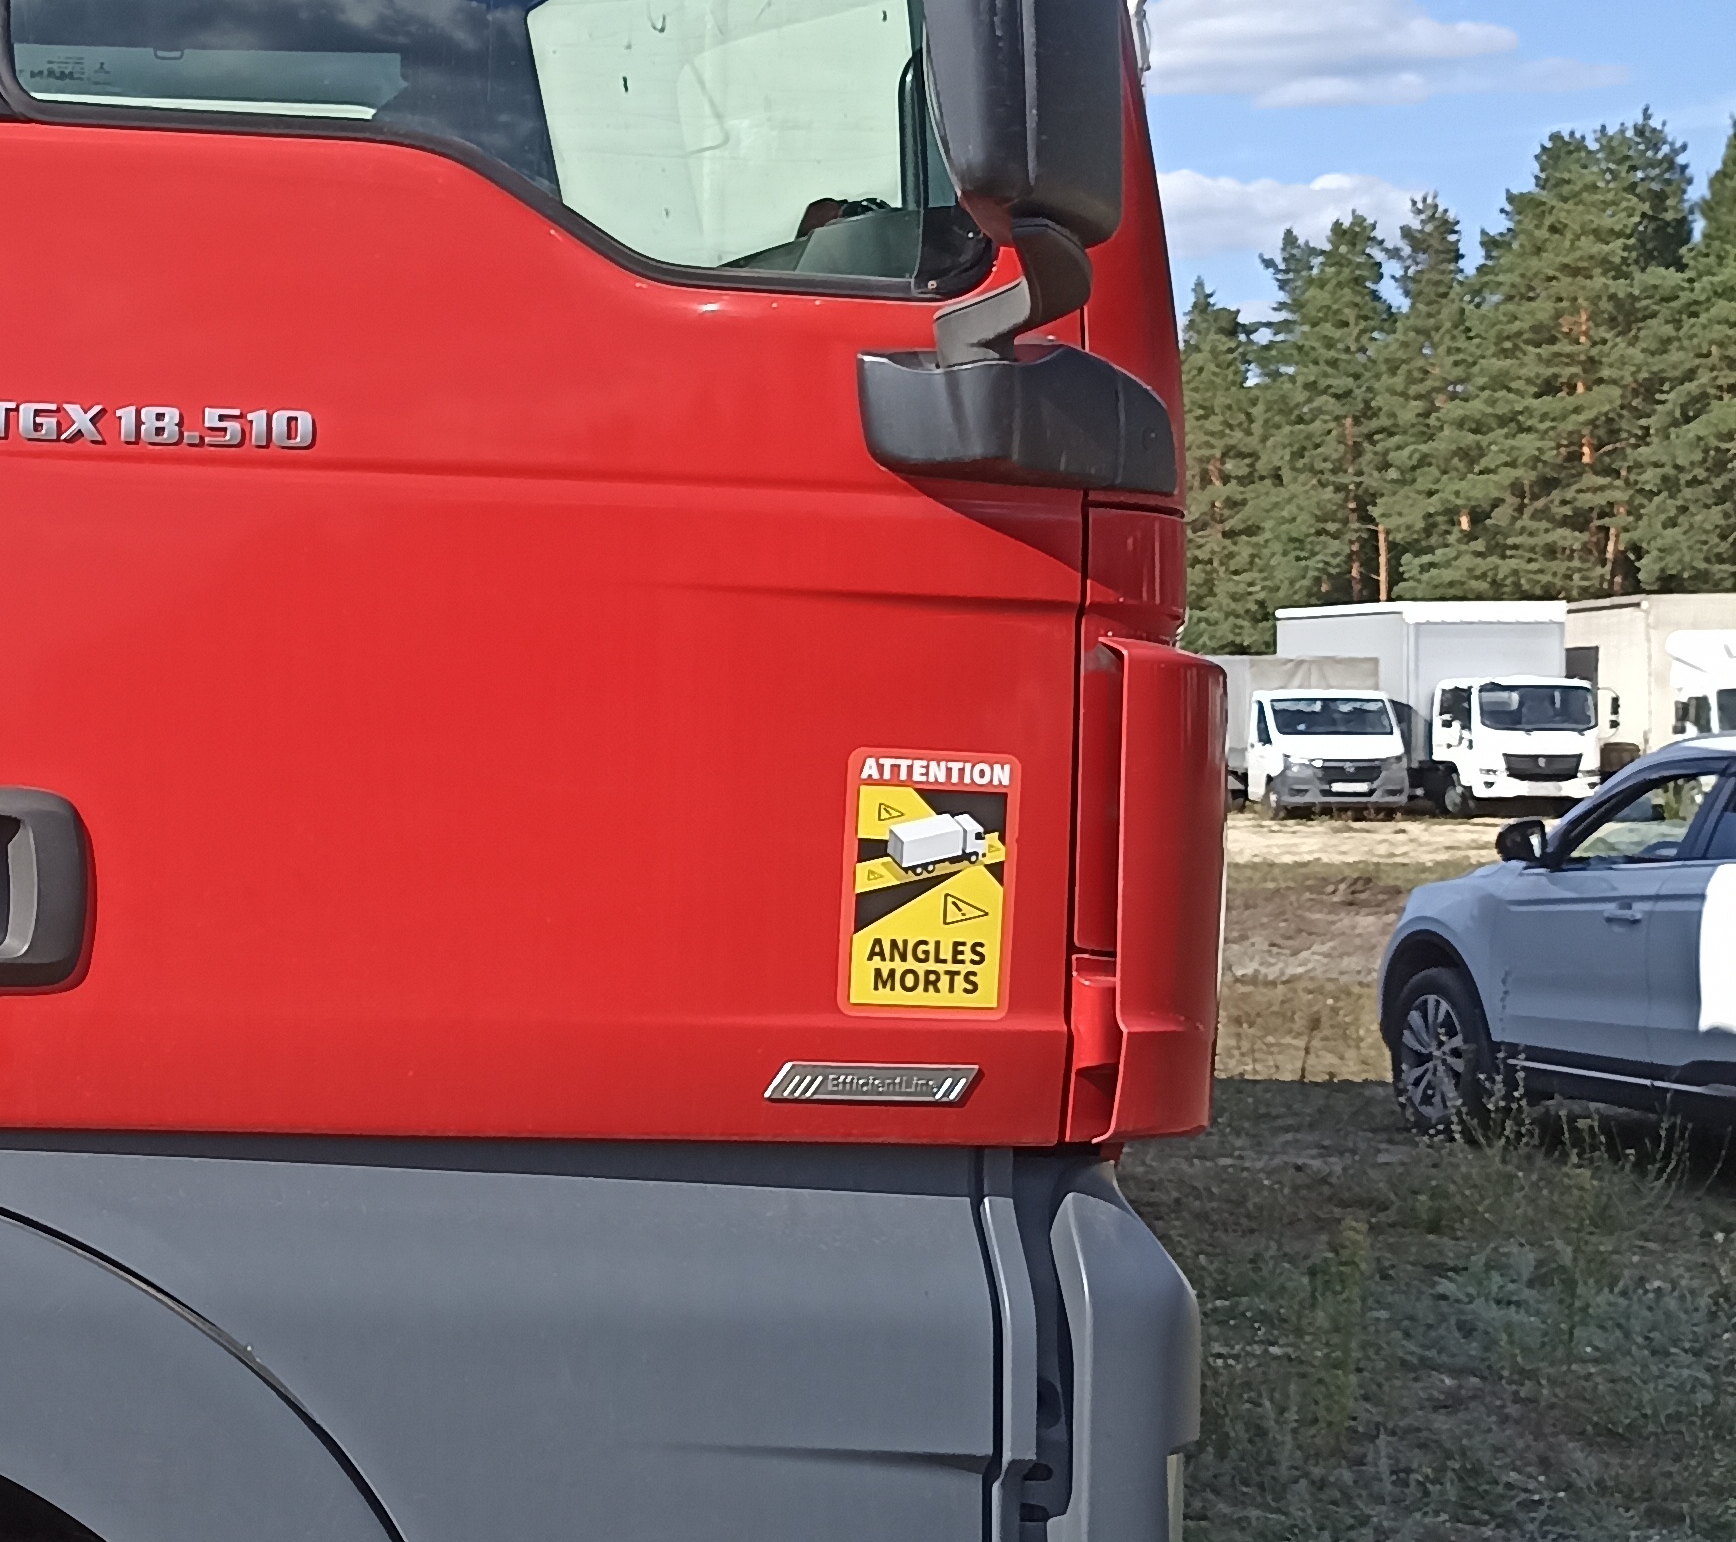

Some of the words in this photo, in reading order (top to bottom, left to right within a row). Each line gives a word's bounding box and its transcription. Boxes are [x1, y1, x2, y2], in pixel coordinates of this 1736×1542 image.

[115, 405, 316, 448] 18.510
[860, 757, 1012, 787] ATTENTION
[866, 937, 987, 966] ANGLES
[871, 967, 980, 995] MORTS
